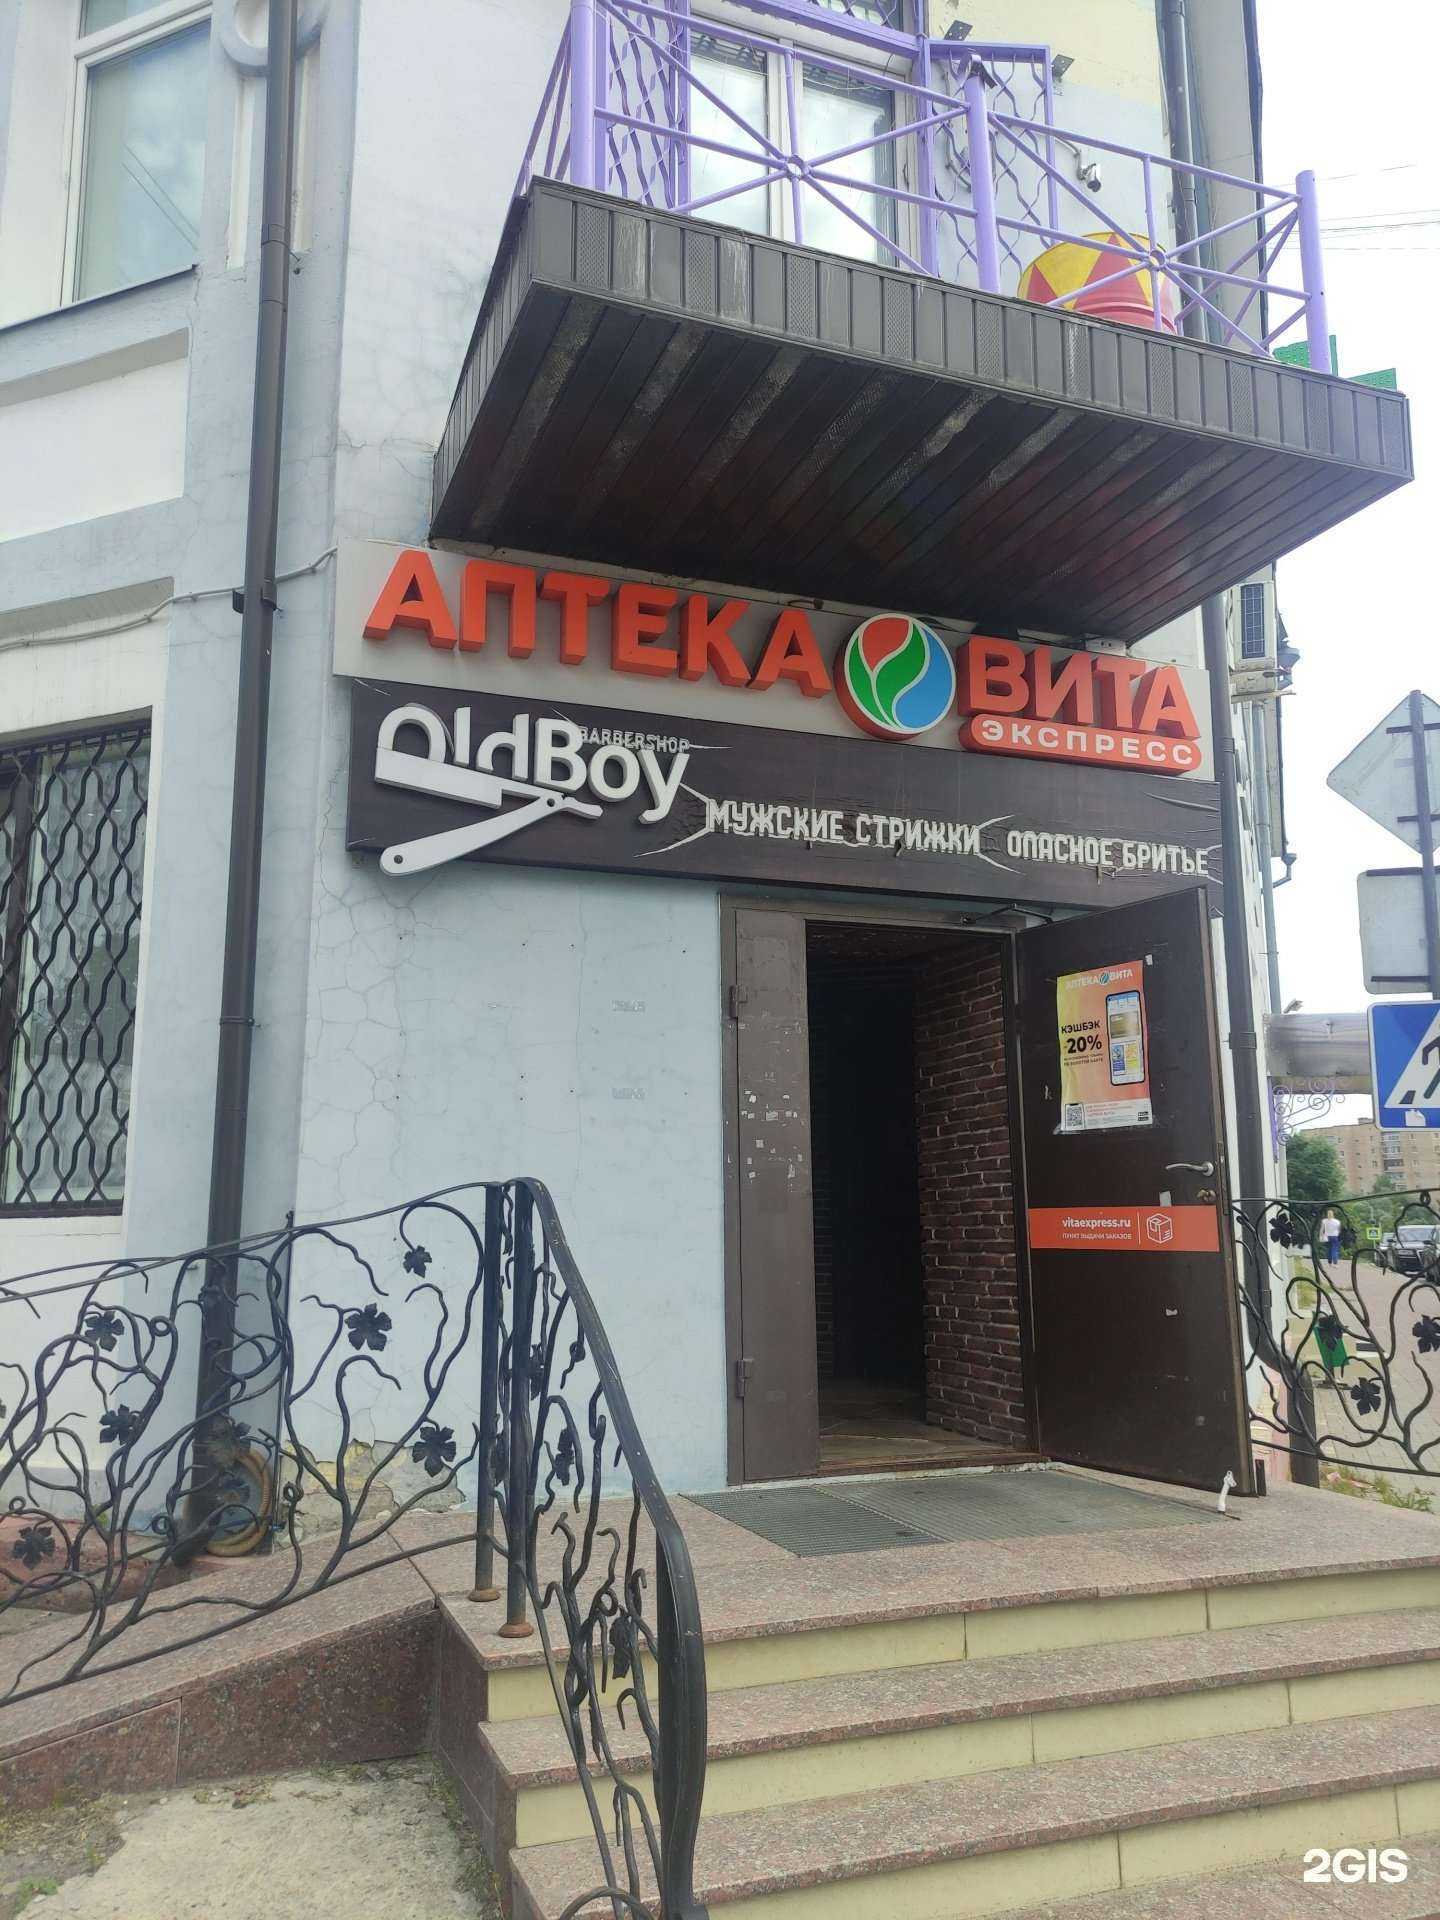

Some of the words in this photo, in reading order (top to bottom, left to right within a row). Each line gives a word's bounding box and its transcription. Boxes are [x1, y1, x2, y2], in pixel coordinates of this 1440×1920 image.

[363, 549, 832, 698] АПТЕКА
[959, 635, 1202, 741] ВИТА
[578, 725, 690, 753] BARBERSHOP
[981, 719, 1194, 766] ЭКСПРЕСС
[376, 703, 690, 825] OldBoy
[707, 799, 845, 842] МУЖСКИЕ
[855, 812, 981, 856] СТРИЖКИ
[1006, 830, 1115, 867] ОПАСНОЕ
[1121, 839, 1209, 876] БРИТЬЕ
[1061, 1020, 1101, 1035] КЭШБЭК
[1062, 1217, 1131, 1229] vitaexpress.ru
